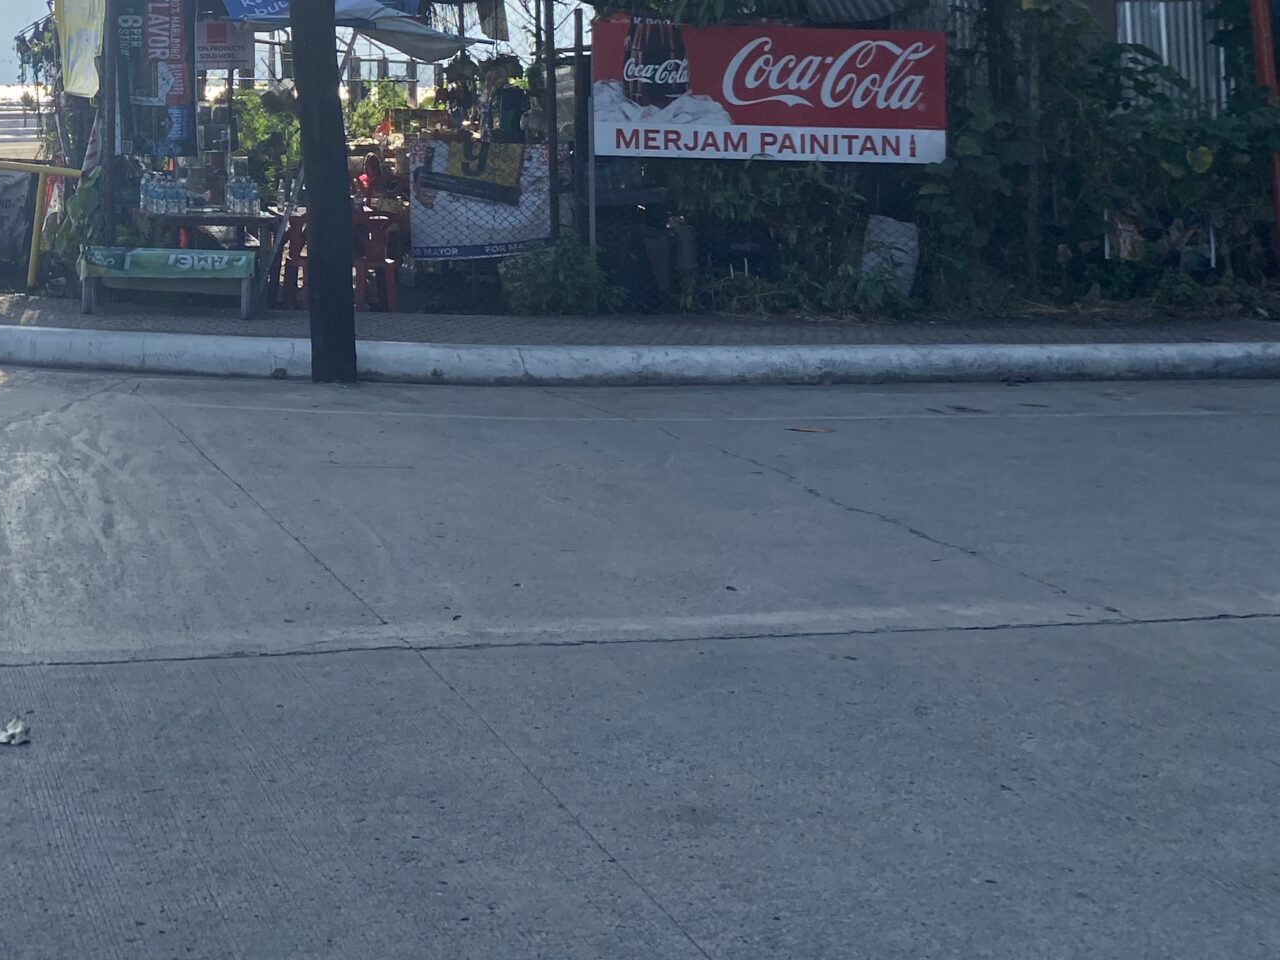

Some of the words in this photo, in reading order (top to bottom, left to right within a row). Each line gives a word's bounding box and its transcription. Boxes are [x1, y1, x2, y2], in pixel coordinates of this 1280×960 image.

[130, 28, 143, 48] PER
[200, 52, 217, 60] SOLD
[623, 57, 690, 84] Coca-Cola
[722, 36, 935, 110] Coca-Cola
[615, 128, 748, 154] MERJAM
[759, 132, 900, 157] PAINITAN
[424, 247, 459, 257] MAYOR
[485, 244, 506, 254] FOR
